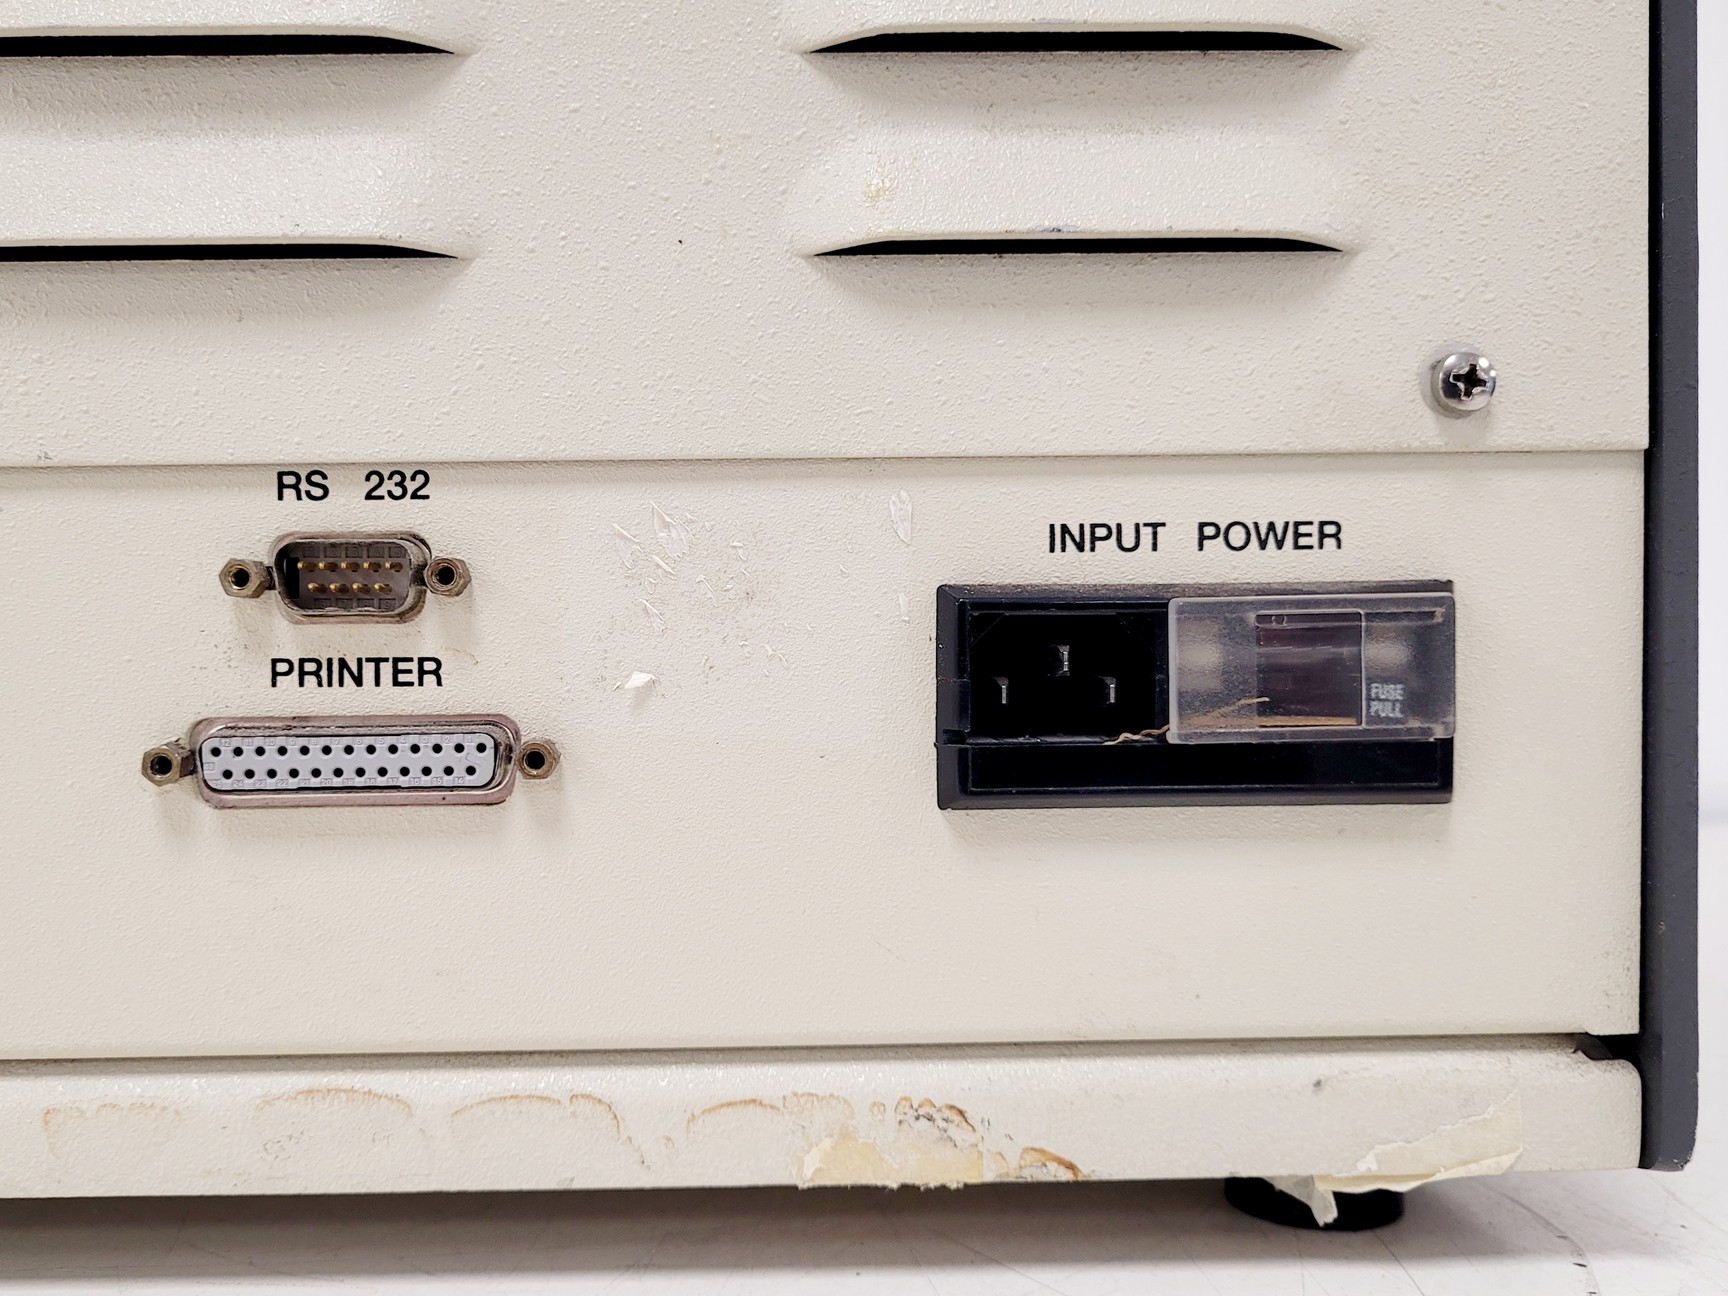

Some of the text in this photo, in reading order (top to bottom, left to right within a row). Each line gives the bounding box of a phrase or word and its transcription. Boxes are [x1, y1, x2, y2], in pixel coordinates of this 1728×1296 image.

[276, 470, 430, 501] RS 232
[1049, 521, 1342, 553] INPUT POWER
[271, 657, 443, 688] PRINTER
[1370, 683, 1405, 700] FUSE
[1370, 700, 1404, 718] PULL
